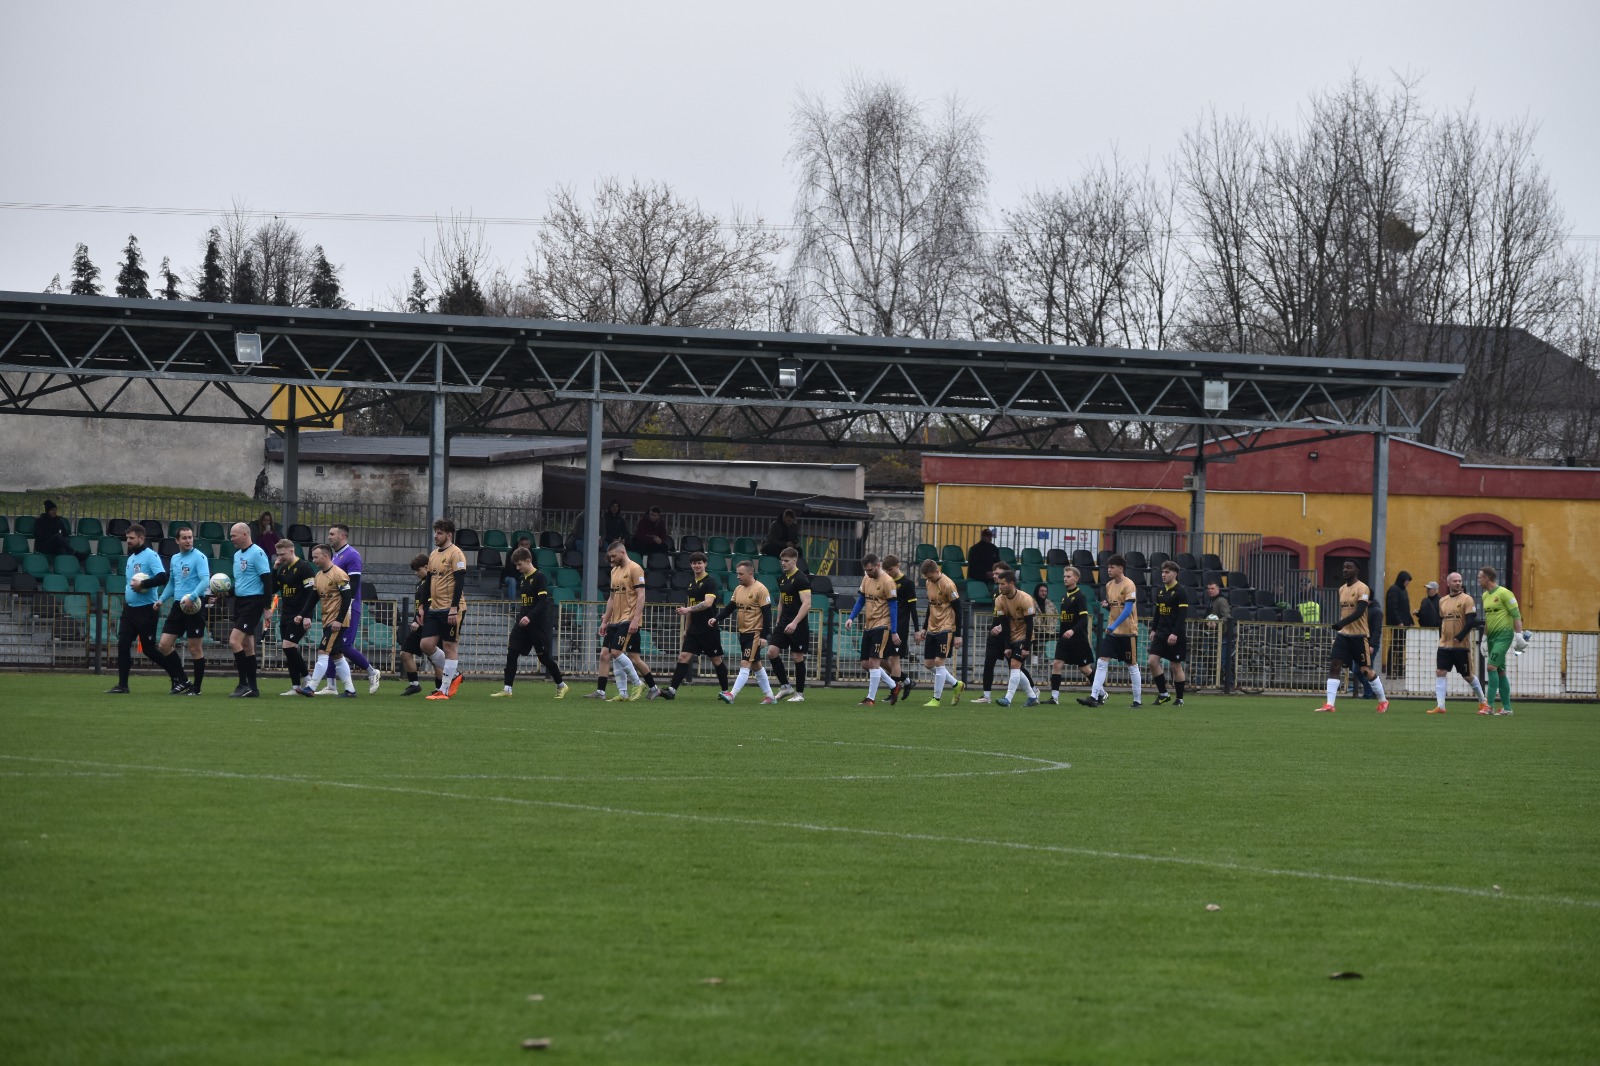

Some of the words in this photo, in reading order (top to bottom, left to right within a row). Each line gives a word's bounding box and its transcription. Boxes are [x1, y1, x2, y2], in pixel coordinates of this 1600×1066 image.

[449, 627, 454, 637] 6
[617, 635, 626, 646] 19
[743, 648, 751, 658] 18
[939, 643, 947, 654] 15
[1360, 653, 1366, 662] 3
[1490, 652, 1499, 662] 12
